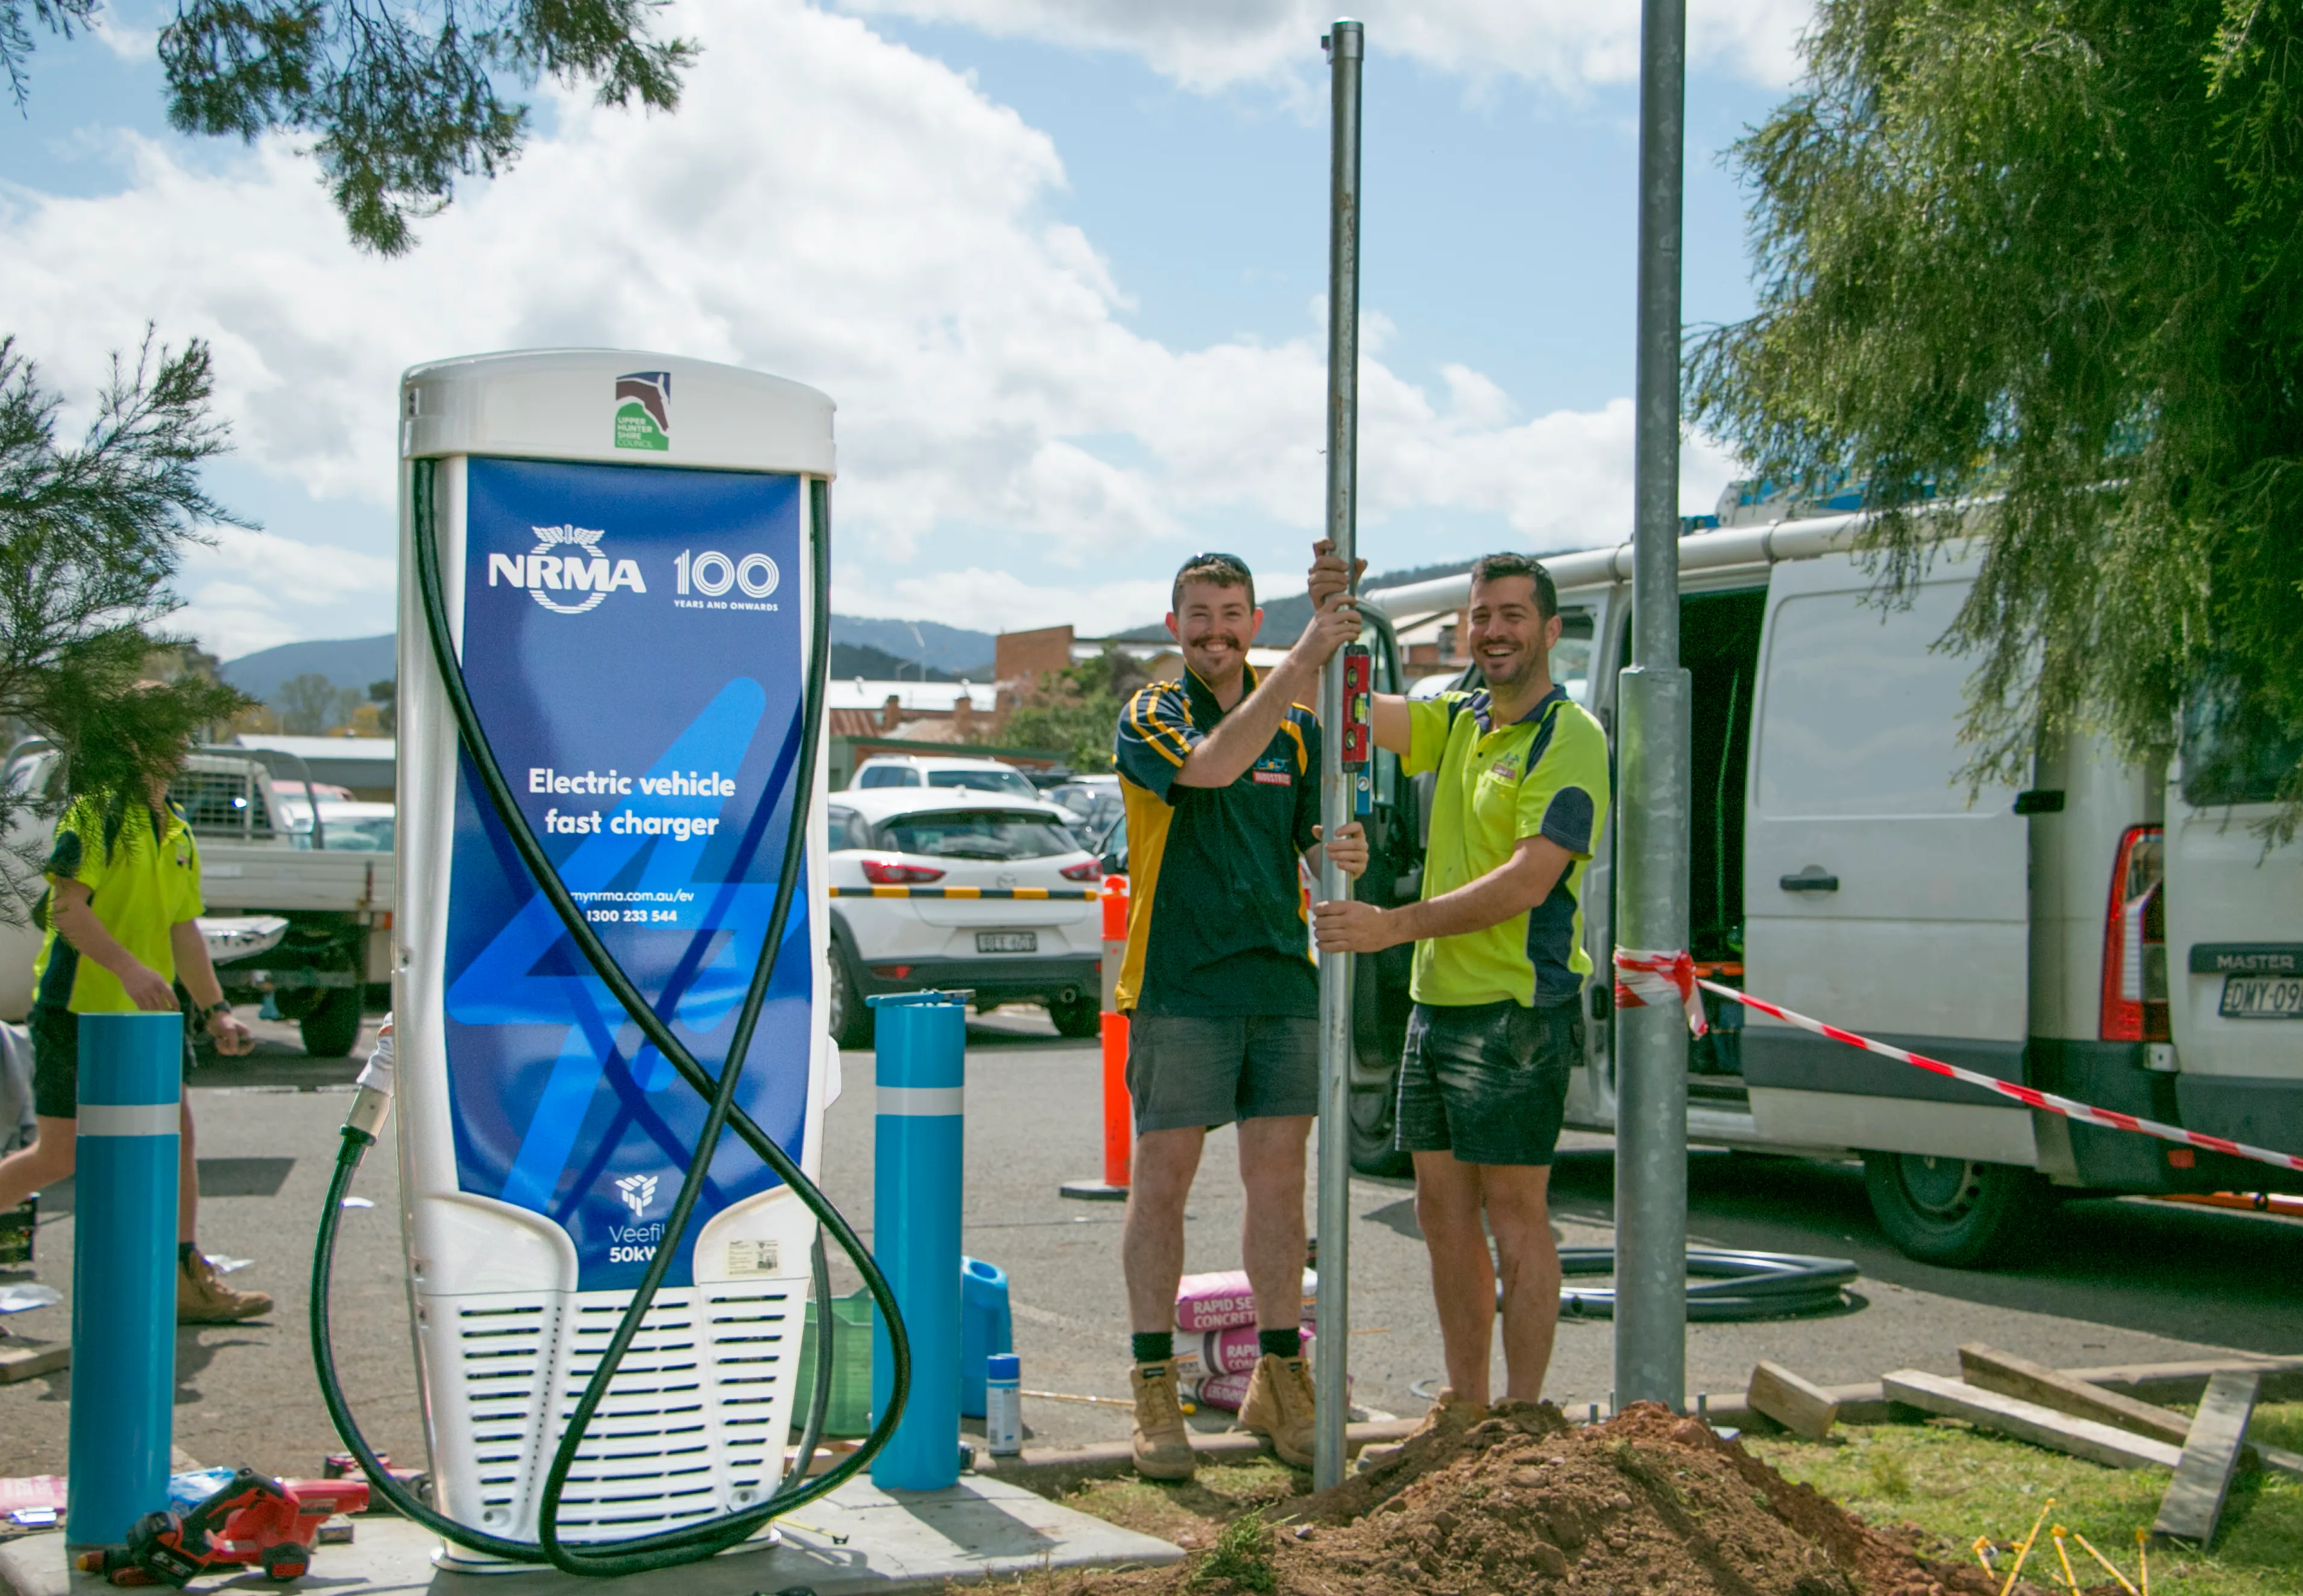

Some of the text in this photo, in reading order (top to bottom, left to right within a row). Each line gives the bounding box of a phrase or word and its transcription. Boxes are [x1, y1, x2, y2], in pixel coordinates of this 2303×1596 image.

[617, 416, 646, 425] UPPER
[617, 424, 652, 433] HUNTER
[617, 439, 653, 448] COUNCIL
[488, 553, 647, 593] NRMA
[673, 548, 780, 598] 100
[673, 600, 779, 612] YEARS AND ONWARDS
[528, 768, 736, 797] Electric vehicle
[545, 808, 719, 842] fast charger
[570, 888, 695, 904] mynrma.com.au/ev
[586, 910, 677, 922] 1300 233 544
[2216, 954, 2295, 969] MASTER
[1193, 1295, 1255, 1315] RAPID SE
